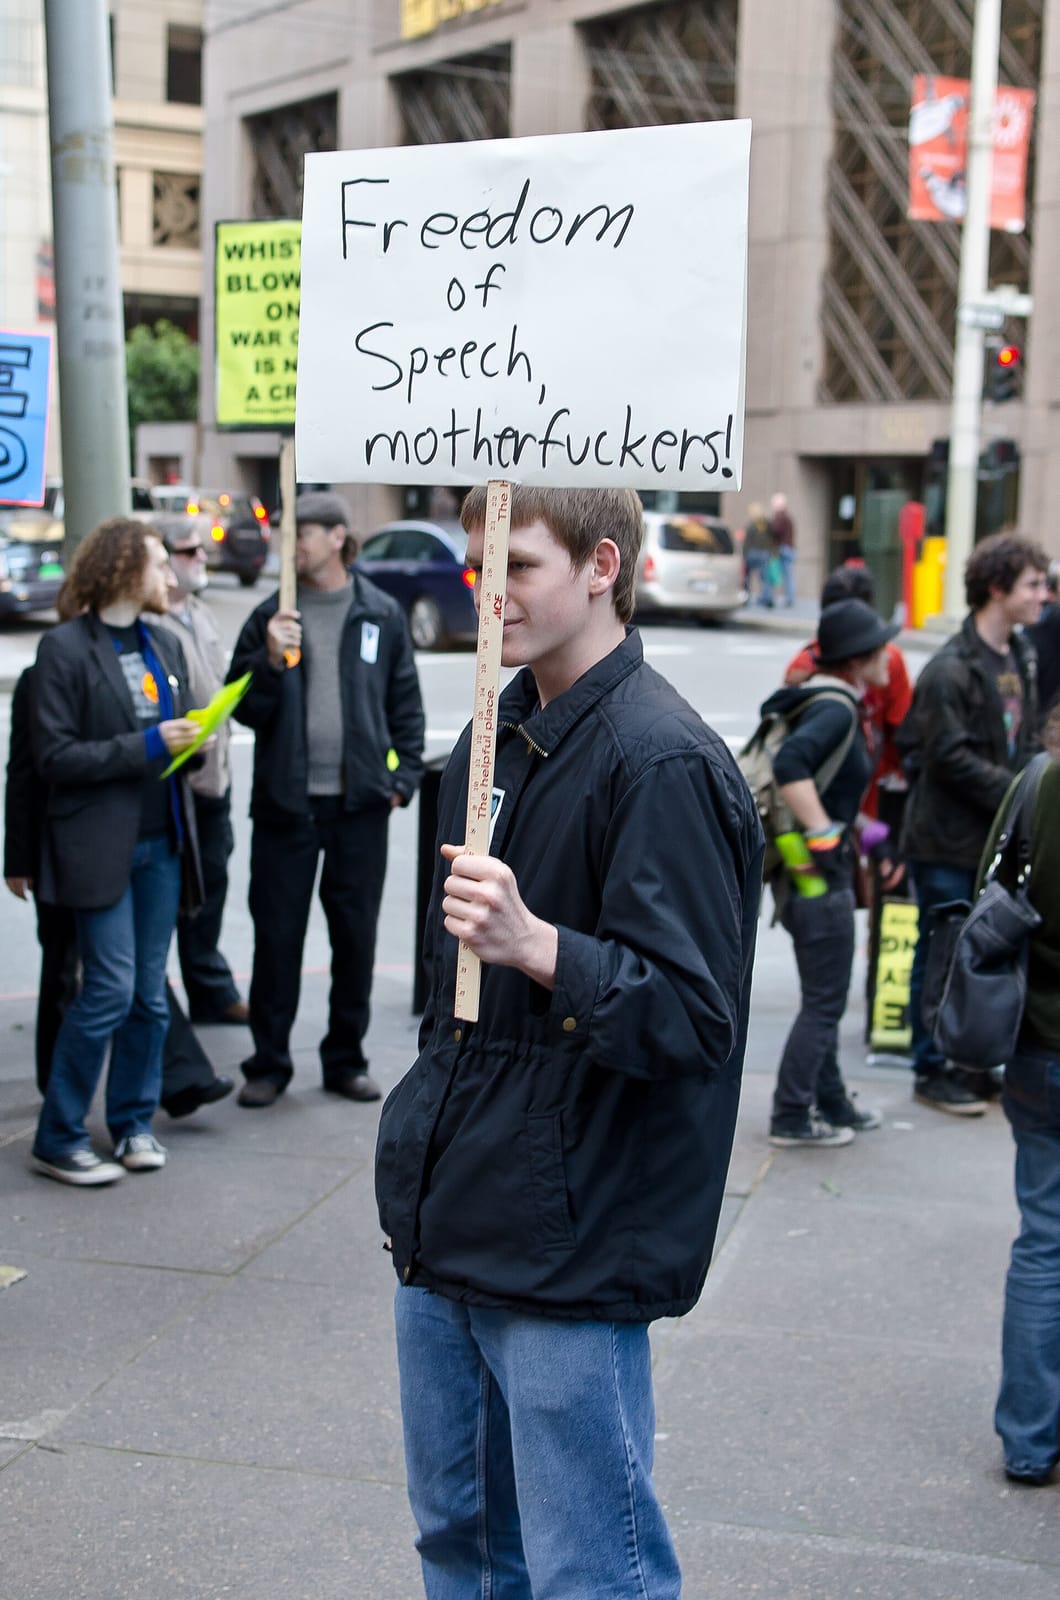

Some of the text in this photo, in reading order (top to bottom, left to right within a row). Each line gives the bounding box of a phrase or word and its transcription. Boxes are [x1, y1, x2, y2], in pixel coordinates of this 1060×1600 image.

[341, 179, 634, 259] Freedom
[226, 272, 300, 293] BLOW
[447, 263, 506, 312] of
[230, 330, 281, 346] WAR
[254, 358, 275, 374] IS
[355, 322, 546, 405] Speech,
[246, 384, 260, 400] A
[365, 405, 733, 478] motherfuckers!
[498, 492, 508, 521] The
[493, 593, 503, 620] ACE
[478, 685, 495, 820] The helpful place.
